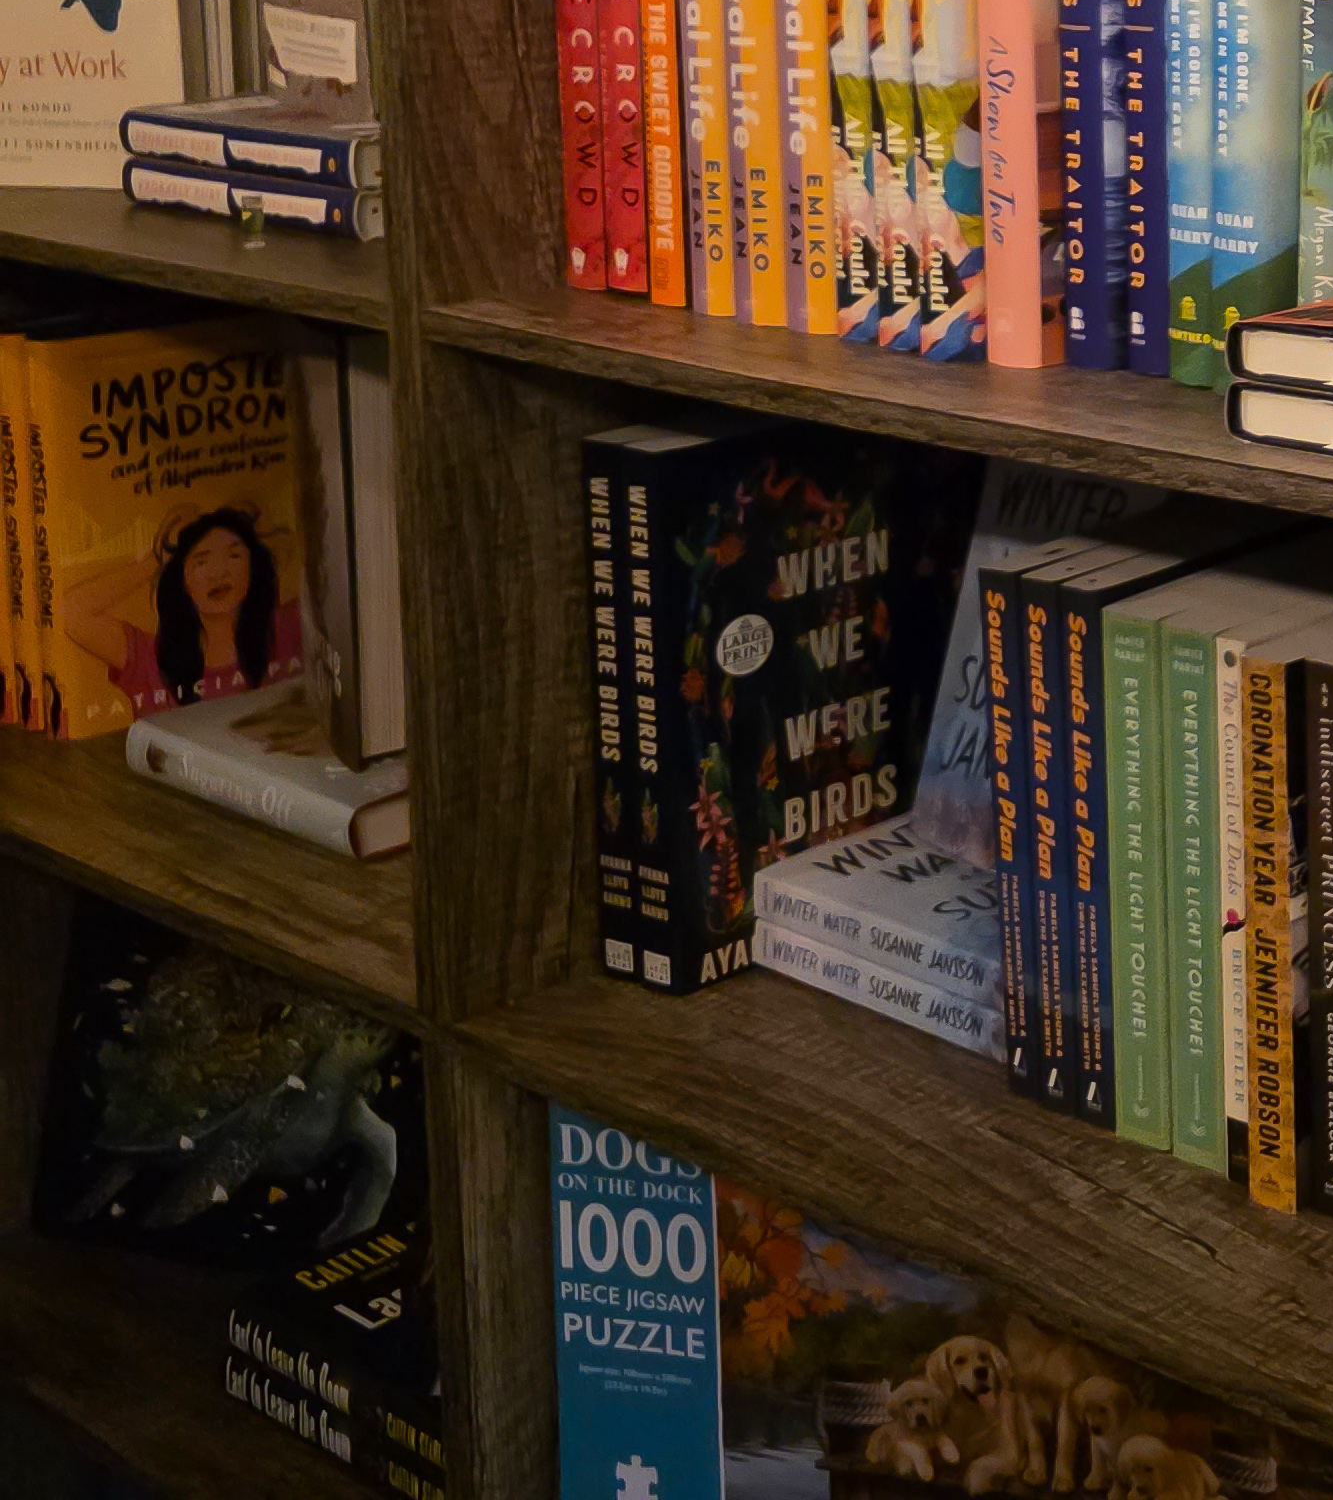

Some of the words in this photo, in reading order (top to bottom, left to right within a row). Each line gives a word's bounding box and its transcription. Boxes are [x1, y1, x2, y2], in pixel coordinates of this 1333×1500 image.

[647, 2, 669, 45] THE
[18, 55, 45, 79] at
[51, 49, 128, 80] Work
[649, 54, 671, 134] SWEET
[1126, 48, 1145, 114] THE
[786, 67, 818, 155] Life
[653, 144, 675, 251] GOODBYE
[788, 182, 803, 266] JEAN
[805, 174, 828, 280] EMIKO
[1127, 131, 1146, 289] TRAITOR
[777, 529, 890, 599] WHEN
[721, 626, 770, 653] LARGE
[721, 641, 770, 663] PRINT
[809, 615, 866, 670] WE
[1066, 611, 1089, 724] Sounds
[783, 687, 893, 762] WERE
[1249, 672, 1277, 835] CORONATION
[1070, 730, 1093, 793] Like
[783, 763, 898, 844] BIRDS
[1073, 798, 1091, 819] a
[1074, 826, 1095, 892] Plan
[1252, 840, 1278, 907] YEAR
[1253, 927, 1280, 1052] JENNIFER
[1256, 1057, 1282, 1160] ROBSON
[557, 1172, 589, 1191] ON
[594, 1177, 637, 1198] THE
[642, 1181, 703, 1205] DOCK
[558, 1199, 708, 1285] 1000
[560, 1282, 621, 1306] PIECE
[625, 1287, 706, 1316] JIGSAW
[563, 1313, 707, 1360] PUZZLE
